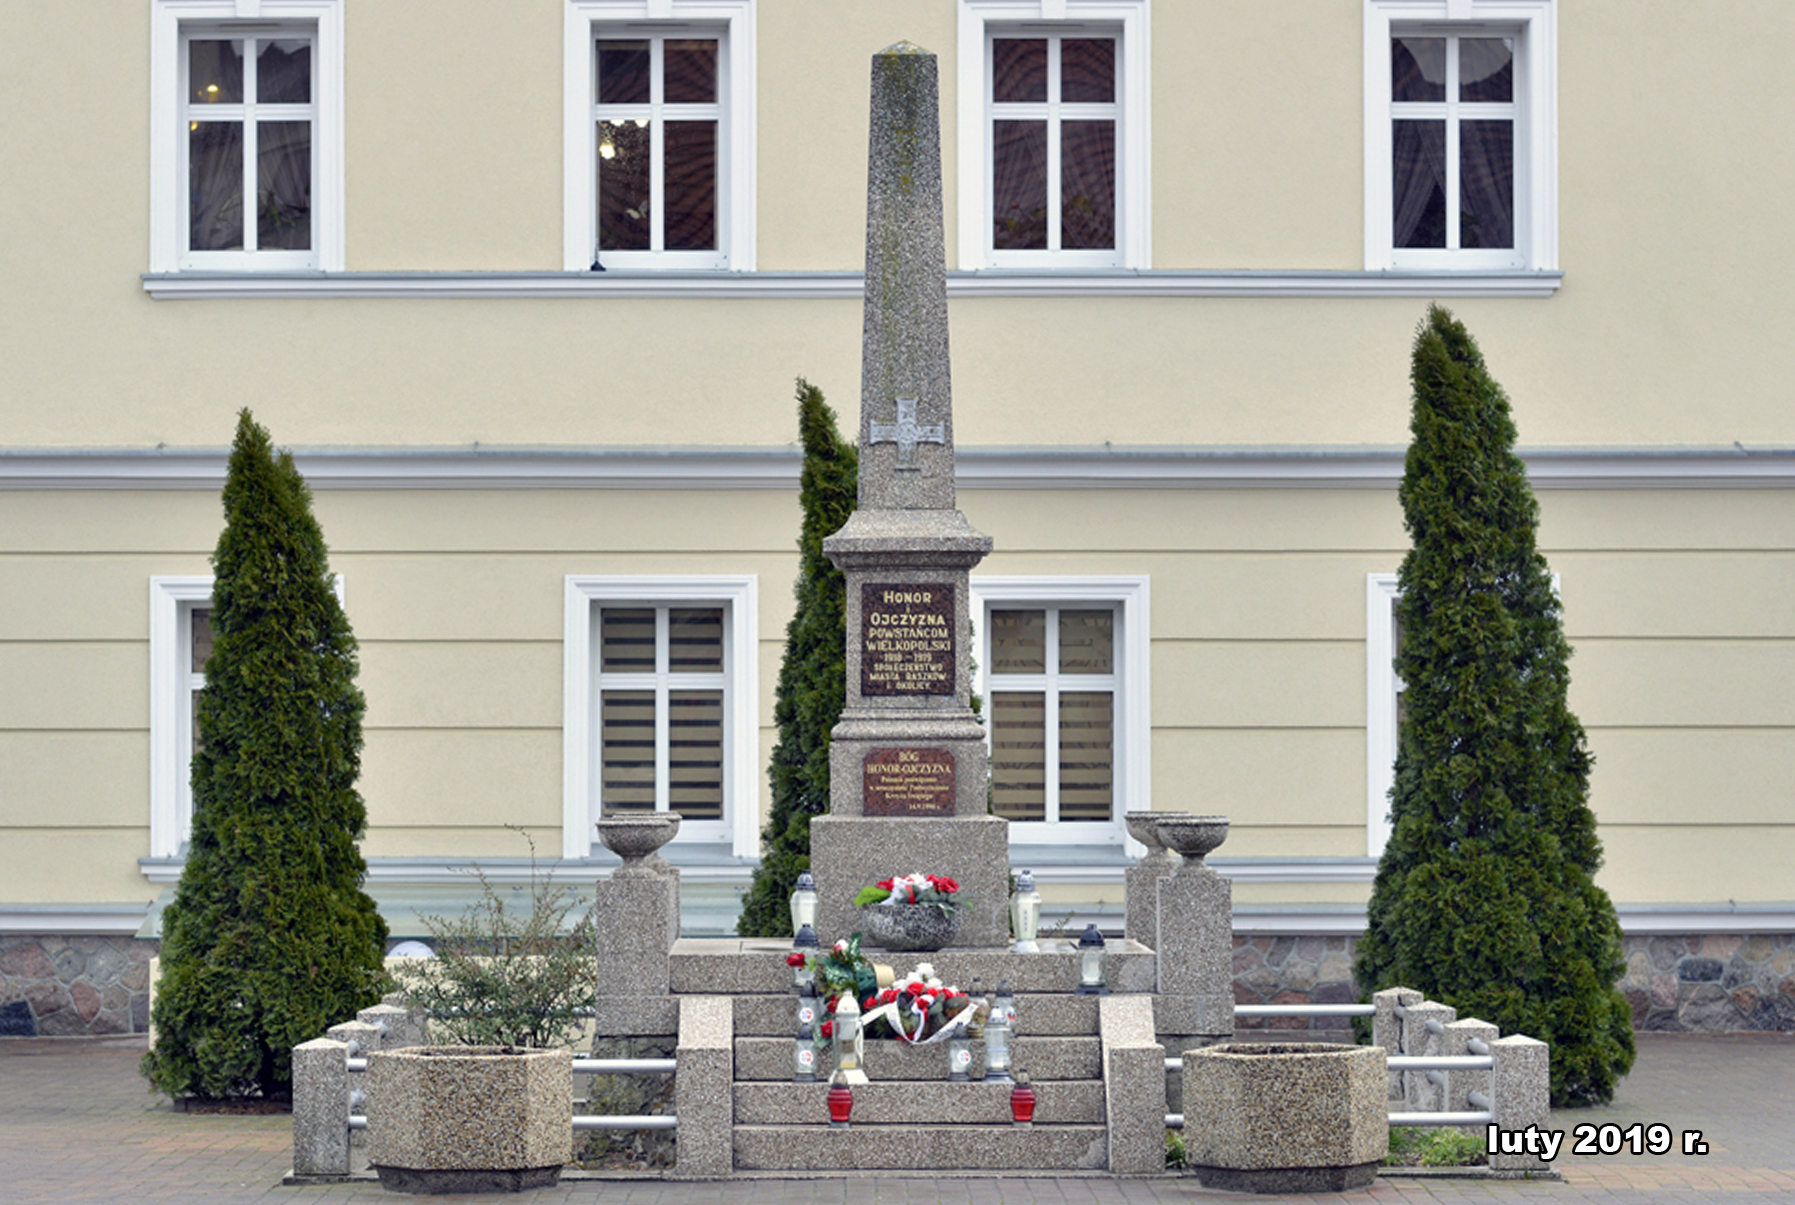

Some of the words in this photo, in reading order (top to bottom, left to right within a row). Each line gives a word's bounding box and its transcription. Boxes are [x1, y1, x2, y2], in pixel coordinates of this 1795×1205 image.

[868, 626, 948, 638] POWSTAŃCOM
[866, 640, 951, 651] WIELKOPOLSKI
[899, 751, 919, 762] BÓG
